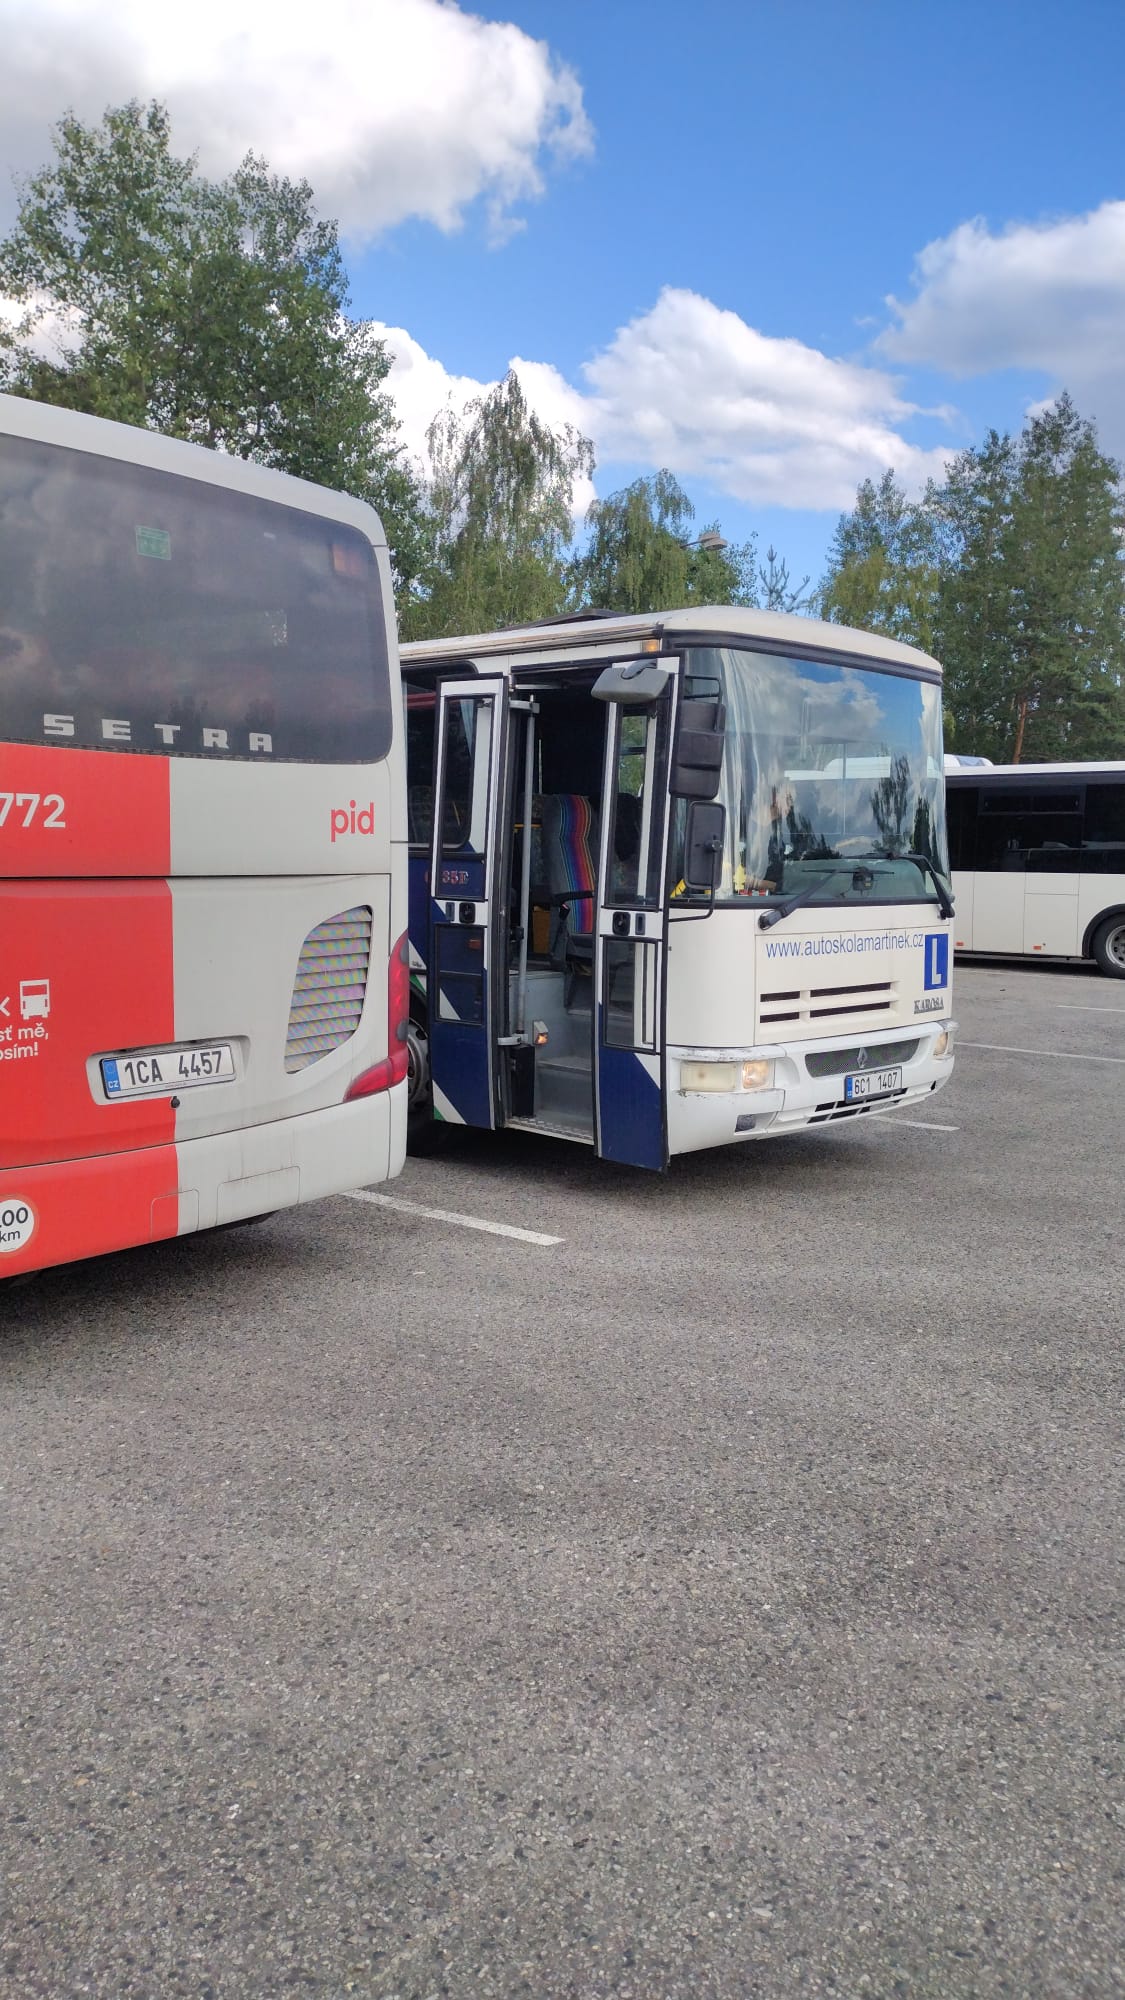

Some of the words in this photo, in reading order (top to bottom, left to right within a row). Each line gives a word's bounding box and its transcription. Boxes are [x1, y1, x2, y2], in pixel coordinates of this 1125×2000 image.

[43, 713, 273, 753] SETRA
[0, 792, 66, 828] 772
[330, 799, 375, 843] pid
[765, 931, 924, 959] www.autoskolamartinek.cz
[931, 937, 942, 985] L
[18, 1022, 49, 1040] mě,
[124, 1058, 163, 1086] 1CA
[178, 1050, 222, 1078] 4457
[854, 1076, 871, 1095] 6C1
[877, 1071, 898, 1091] 1407
[108, 1080, 119, 1089] CZ
[0, 1207, 29, 1228] 00
